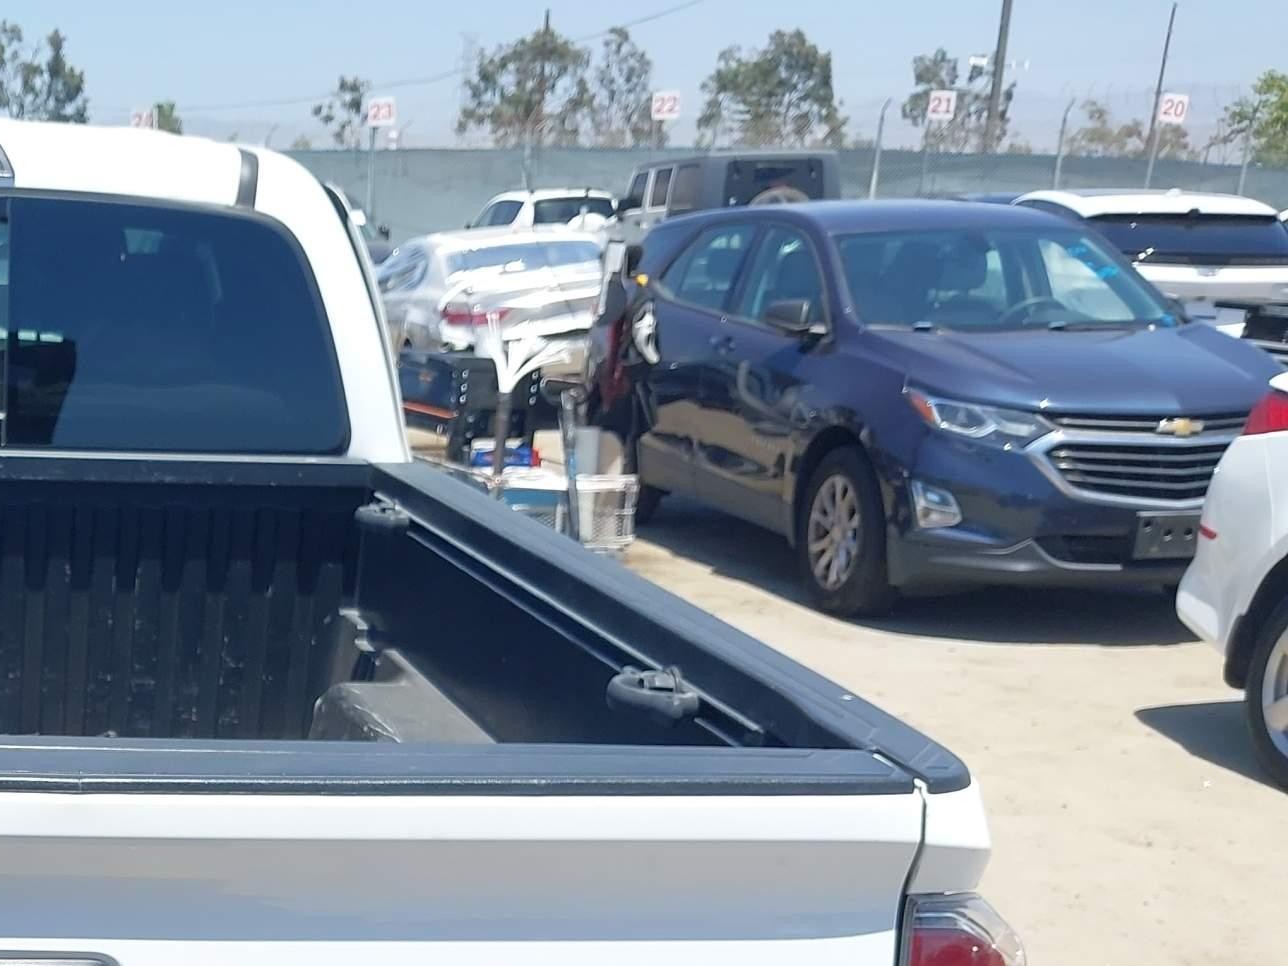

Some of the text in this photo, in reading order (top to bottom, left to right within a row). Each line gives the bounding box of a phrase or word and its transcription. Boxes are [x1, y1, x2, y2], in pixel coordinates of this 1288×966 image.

[655, 96, 678, 113] 22
[931, 96, 951, 113] 21
[1163, 99, 1185, 117] 20
